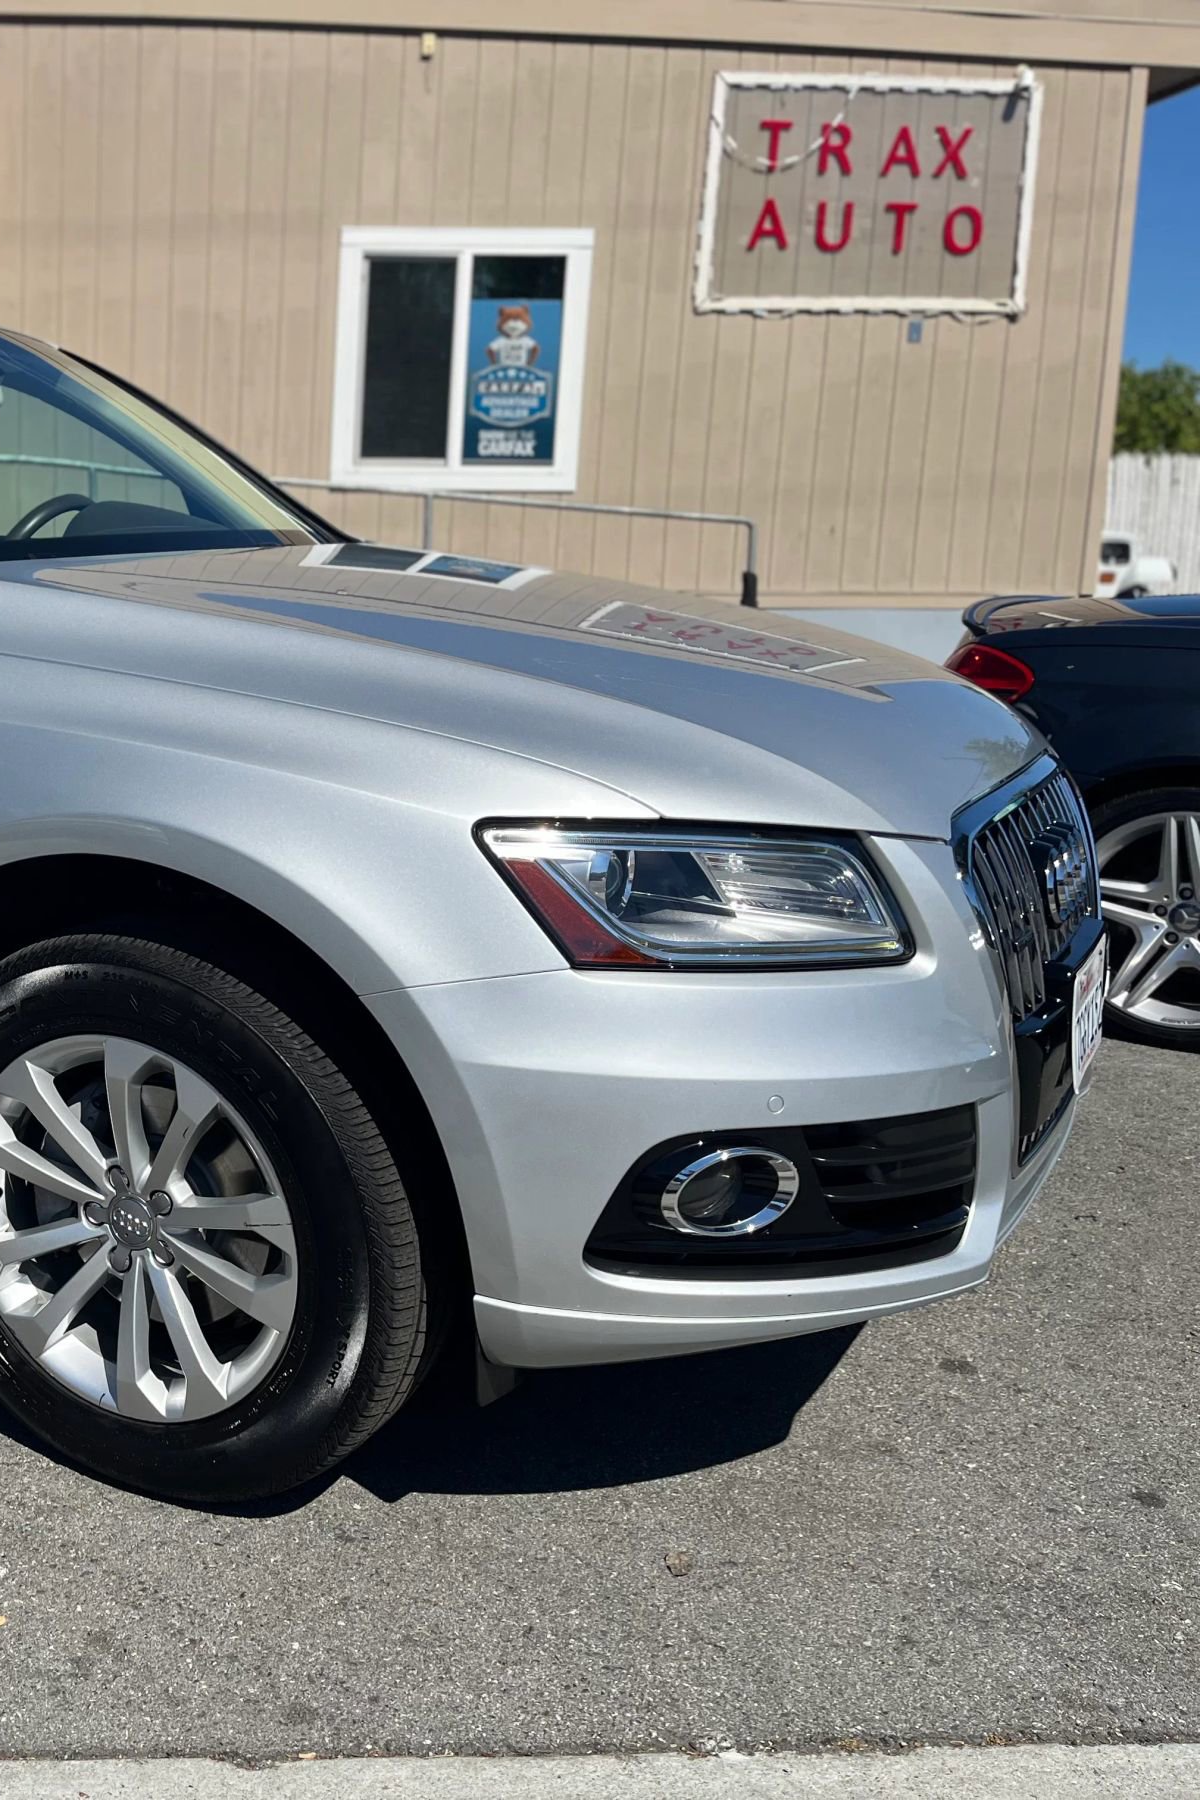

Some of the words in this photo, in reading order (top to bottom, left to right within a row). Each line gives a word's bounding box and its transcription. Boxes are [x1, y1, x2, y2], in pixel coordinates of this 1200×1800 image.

[759, 119, 974, 180] TRAX
[746, 197, 984, 256] AUTO
[325, 1340, 348, 1389] SPORT
